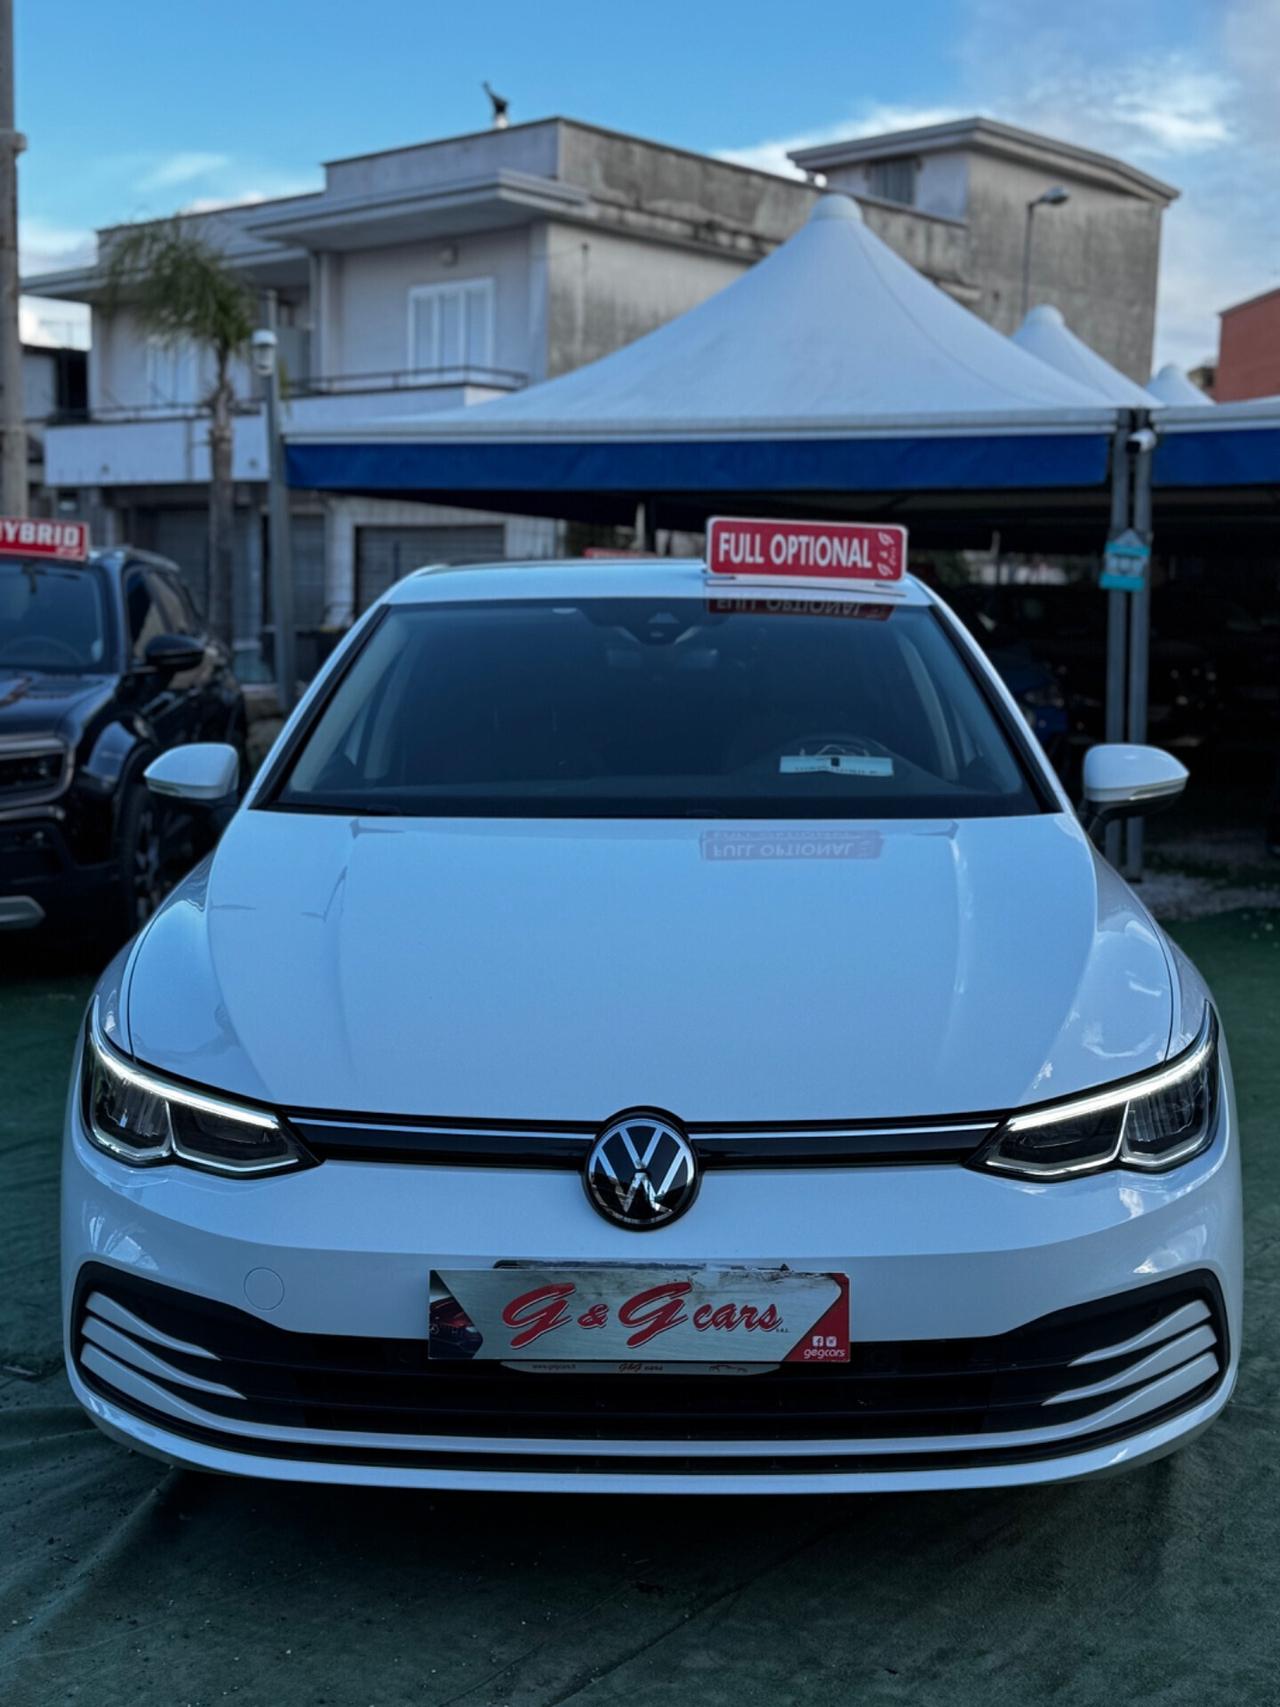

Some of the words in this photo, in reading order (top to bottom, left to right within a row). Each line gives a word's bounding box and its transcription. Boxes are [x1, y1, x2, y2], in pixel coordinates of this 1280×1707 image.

[0, 521, 79, 547] YBRID
[718, 532, 764, 564] FULL
[769, 533, 873, 569] OPTIONAL
[502, 1282, 576, 1349] G
[577, 1303, 609, 1329] &
[618, 1281, 692, 1349] G
[693, 1303, 783, 1332] cars
[803, 1348, 846, 1360] gegcars
